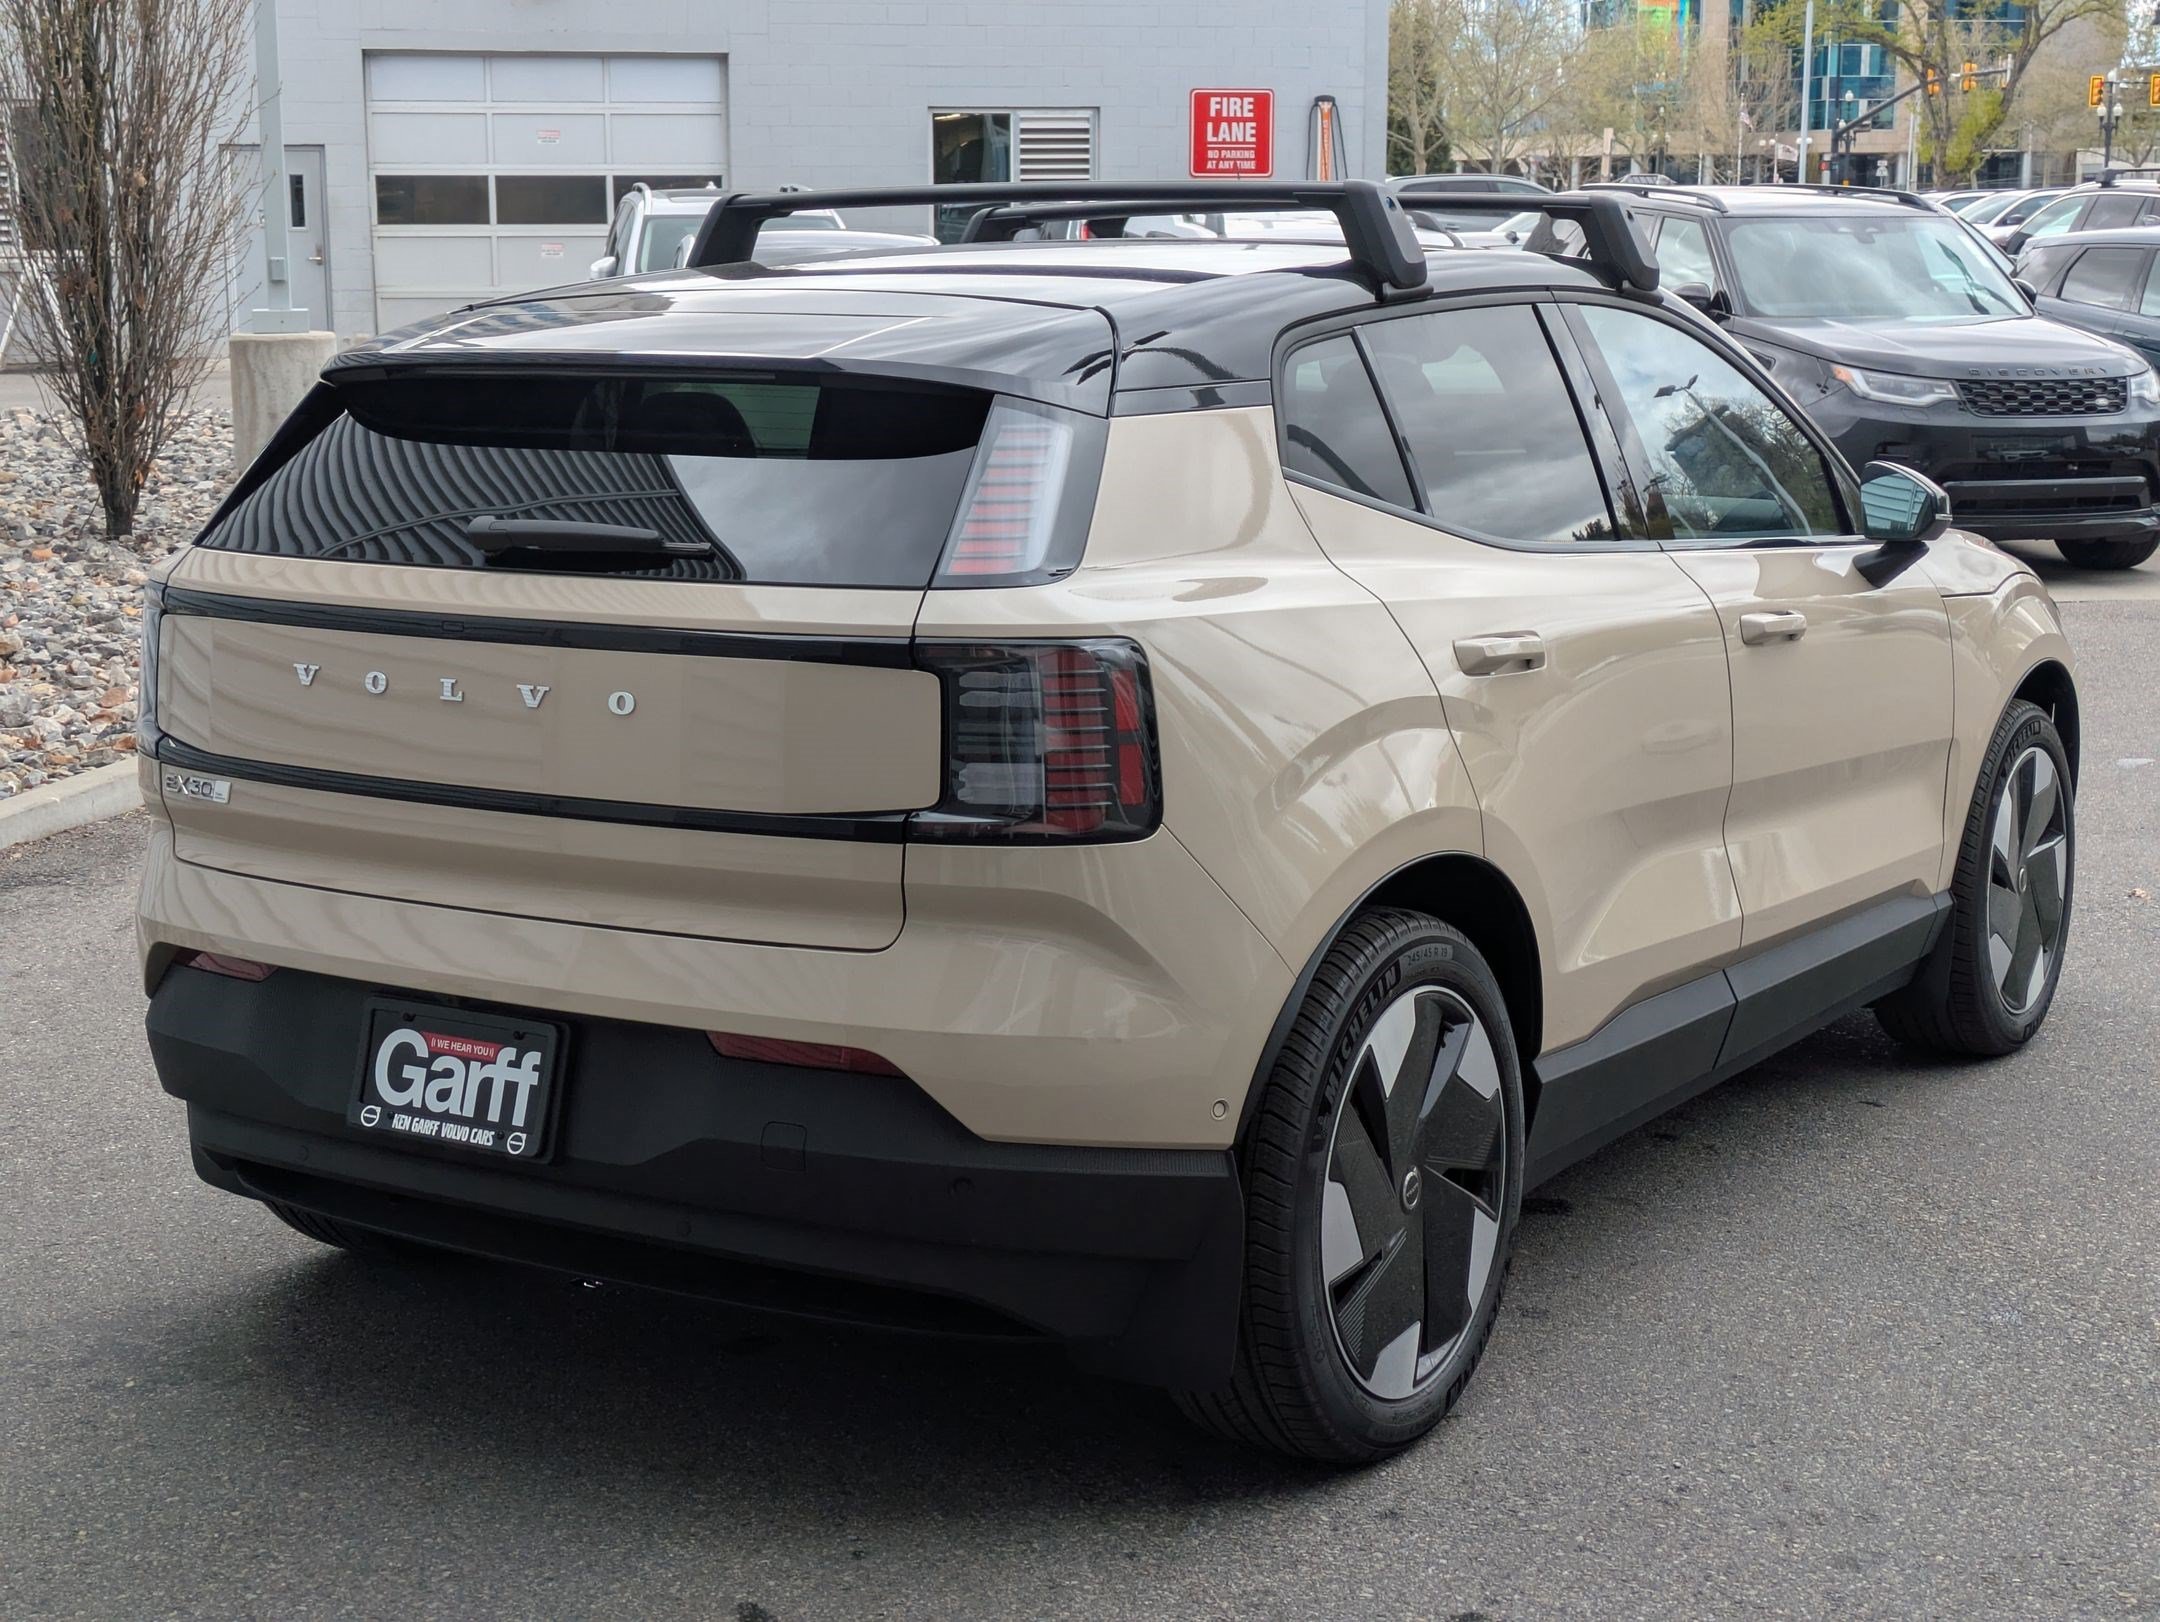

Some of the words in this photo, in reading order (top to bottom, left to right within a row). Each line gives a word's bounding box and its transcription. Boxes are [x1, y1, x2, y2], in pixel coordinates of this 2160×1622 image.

[1209, 96, 1255, 118] FIRE
[1206, 121, 1257, 142] LANE
[1206, 160, 1218, 169] AT
[1218, 160, 1235, 169] ANY
[1236, 160, 1256, 169] TIME
[1207, 150, 1218, 159] NO
[1220, 150, 1256, 159] PARKING
[1968, 367, 2107, 377] DISCOVERY
[293, 663, 637, 715] VOLVO
[165, 773, 215, 800] EX30
[1324, 965, 1398, 1102] MICHELIN
[437, 1039, 450, 1050] WE
[450, 1041, 472, 1054] HEAR
[473, 1045, 489, 1056] YOU
[375, 1028, 541, 1127] Garff
[392, 1113, 411, 1131] KEN
[411, 1117, 440, 1137] GARFF
[441, 1122, 470, 1142] VOLVO
[470, 1128, 495, 1146] CARS
